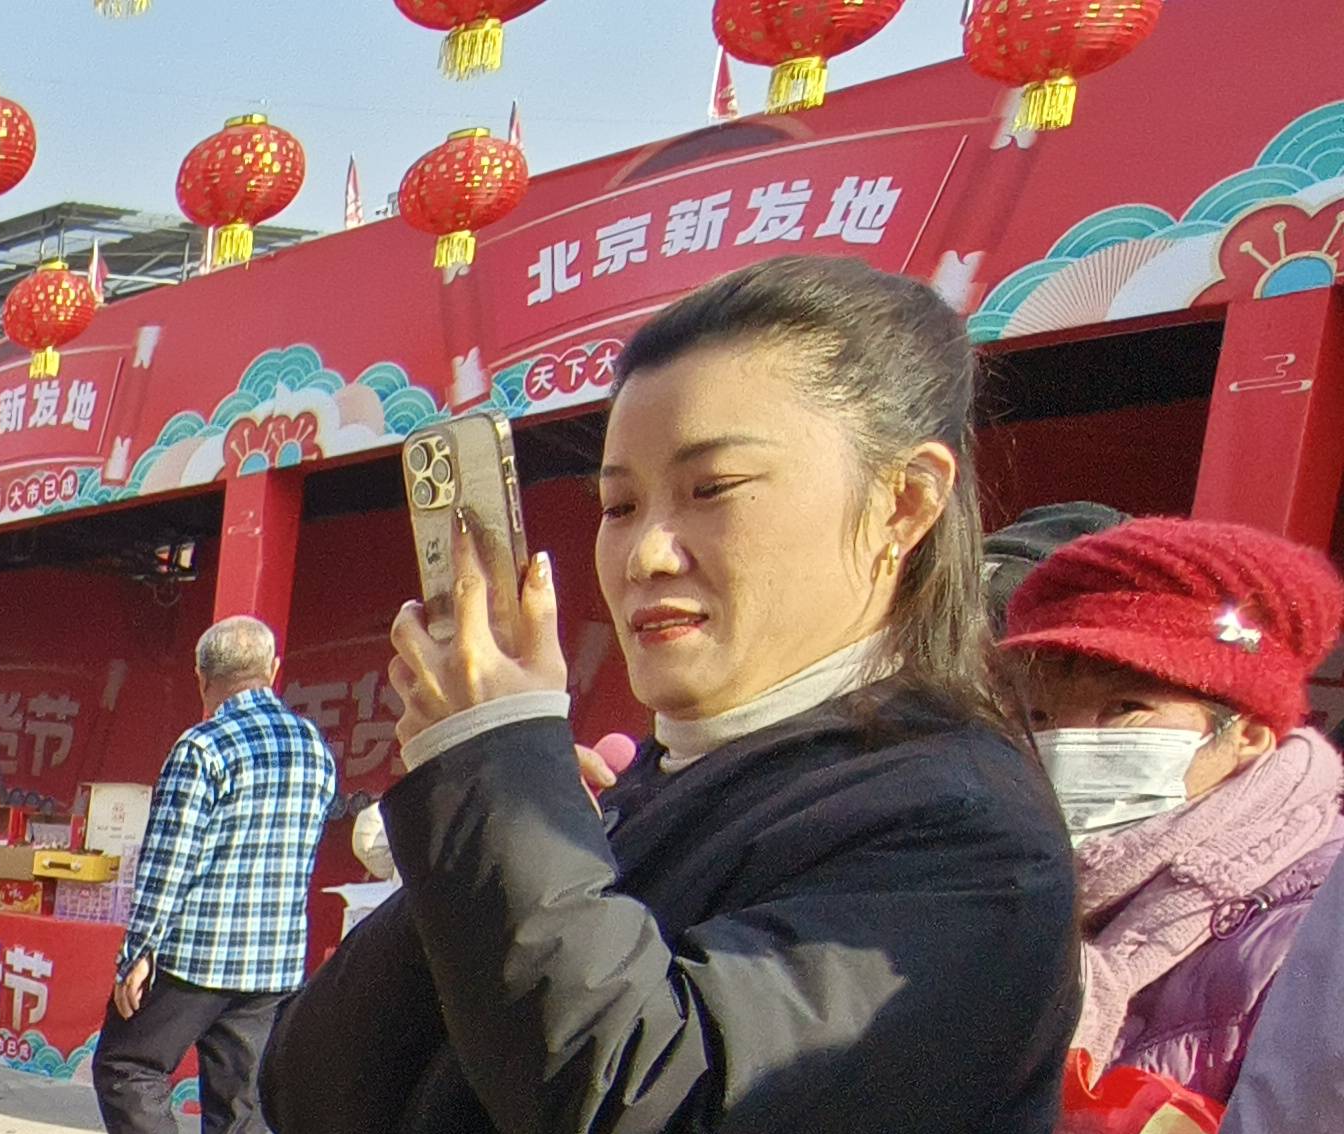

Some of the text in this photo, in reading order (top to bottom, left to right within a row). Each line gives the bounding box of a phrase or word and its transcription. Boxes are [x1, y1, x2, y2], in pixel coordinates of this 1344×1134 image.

[527, 175, 902, 307] 北京新发地
[9, 471, 76, 506] 大市已成
